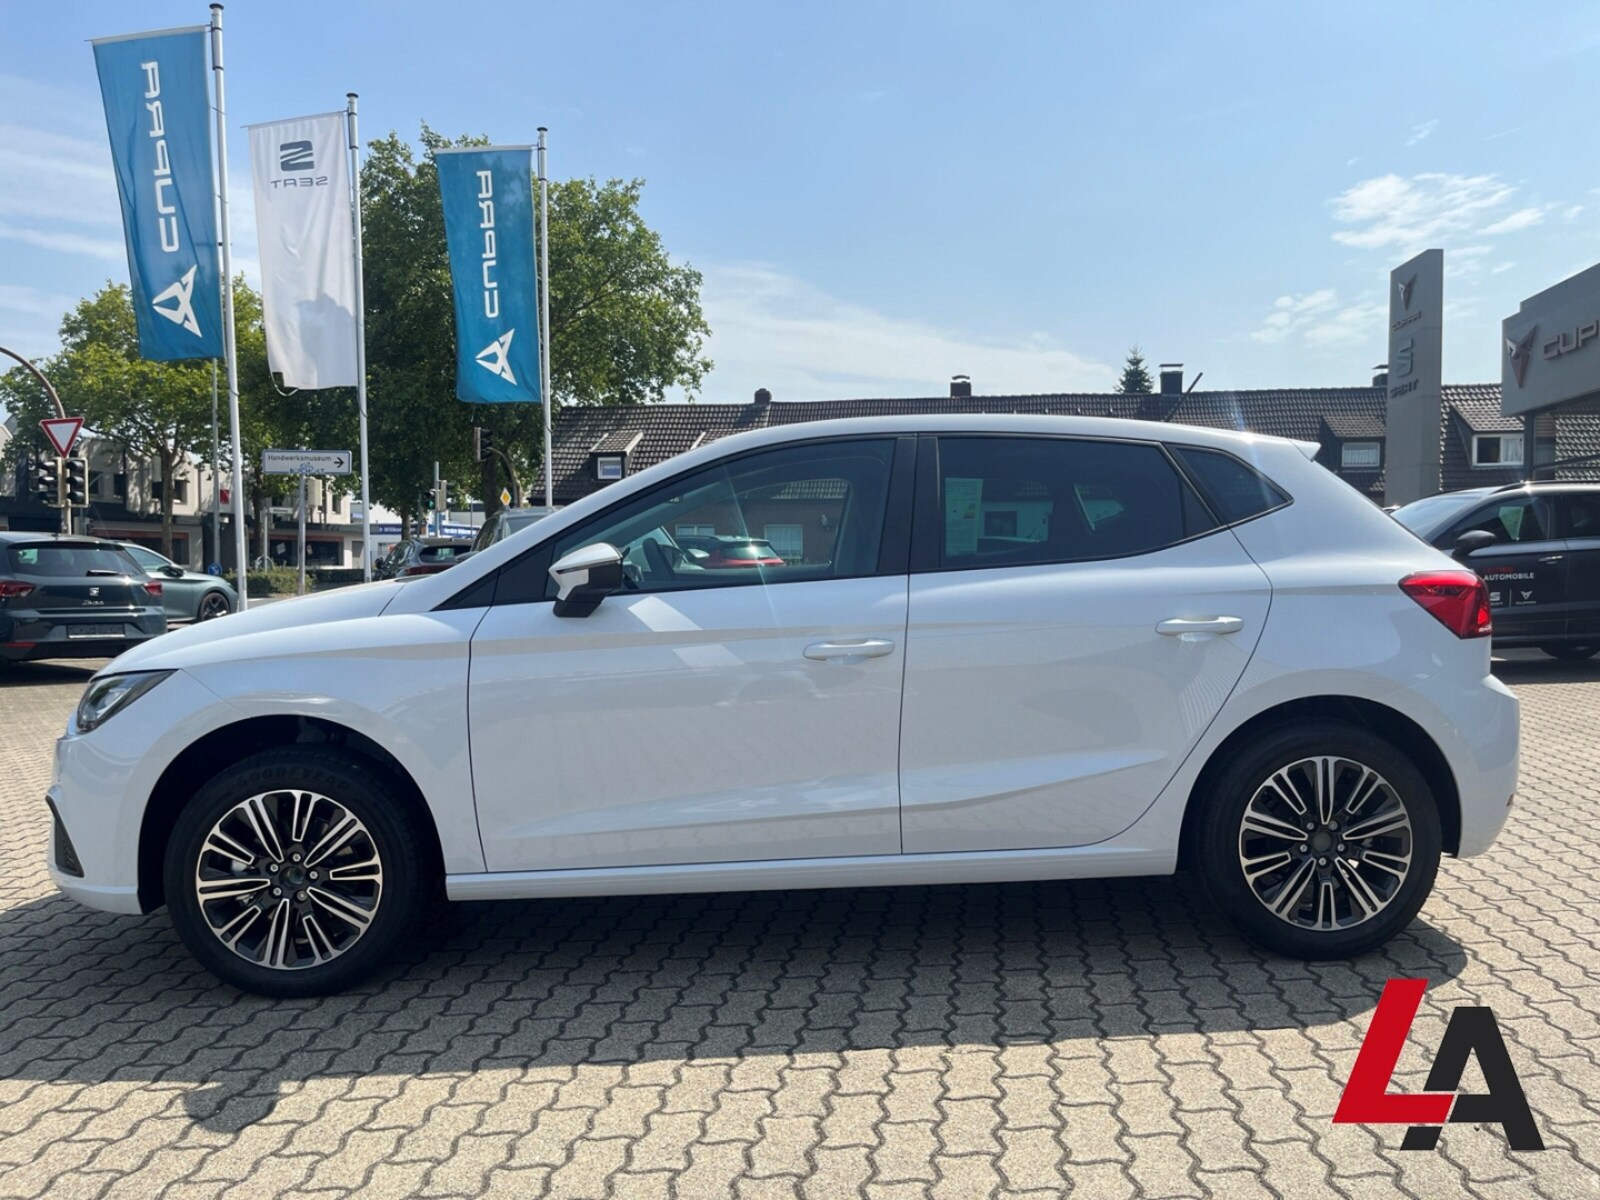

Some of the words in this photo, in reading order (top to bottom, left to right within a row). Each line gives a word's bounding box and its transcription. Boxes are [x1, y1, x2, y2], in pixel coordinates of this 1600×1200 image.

[1543, 320, 1600, 360] CUP
[268, 454, 332, 462] Handwerksmuseum
[1484, 572, 1534, 580] AUTOMOBILE
